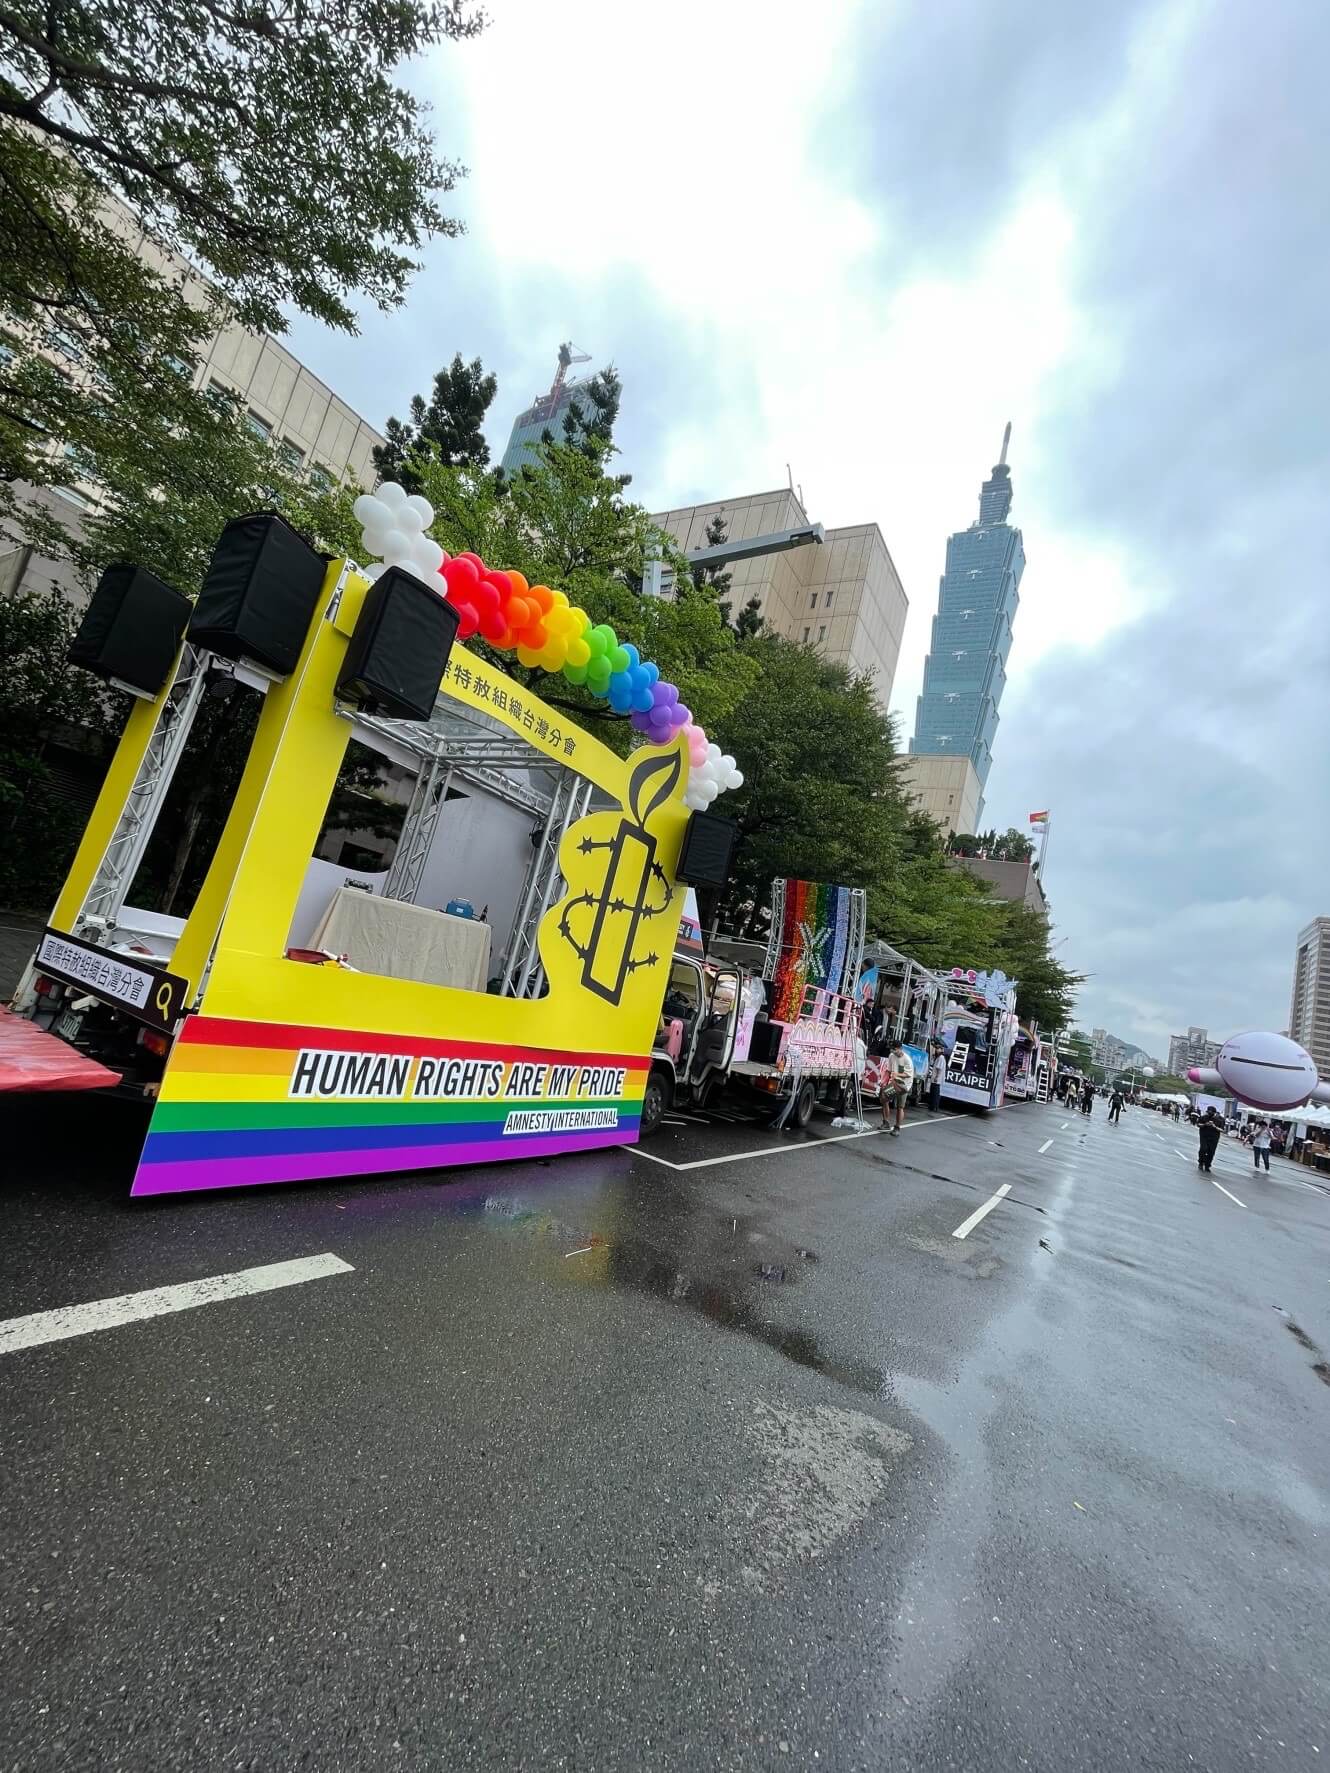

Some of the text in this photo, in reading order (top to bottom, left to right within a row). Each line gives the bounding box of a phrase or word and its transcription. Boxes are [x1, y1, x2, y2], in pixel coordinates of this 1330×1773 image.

[43, 940, 145, 1001] 國際特赦組織台灣分會
[291, 1052, 625, 1096] HUMAN RIGHTS ARE MY PRIDE
[945, 1070, 989, 1089] RTAIPEI
[505, 1112, 618, 1133] AMNESTY INTERNATIONAL
